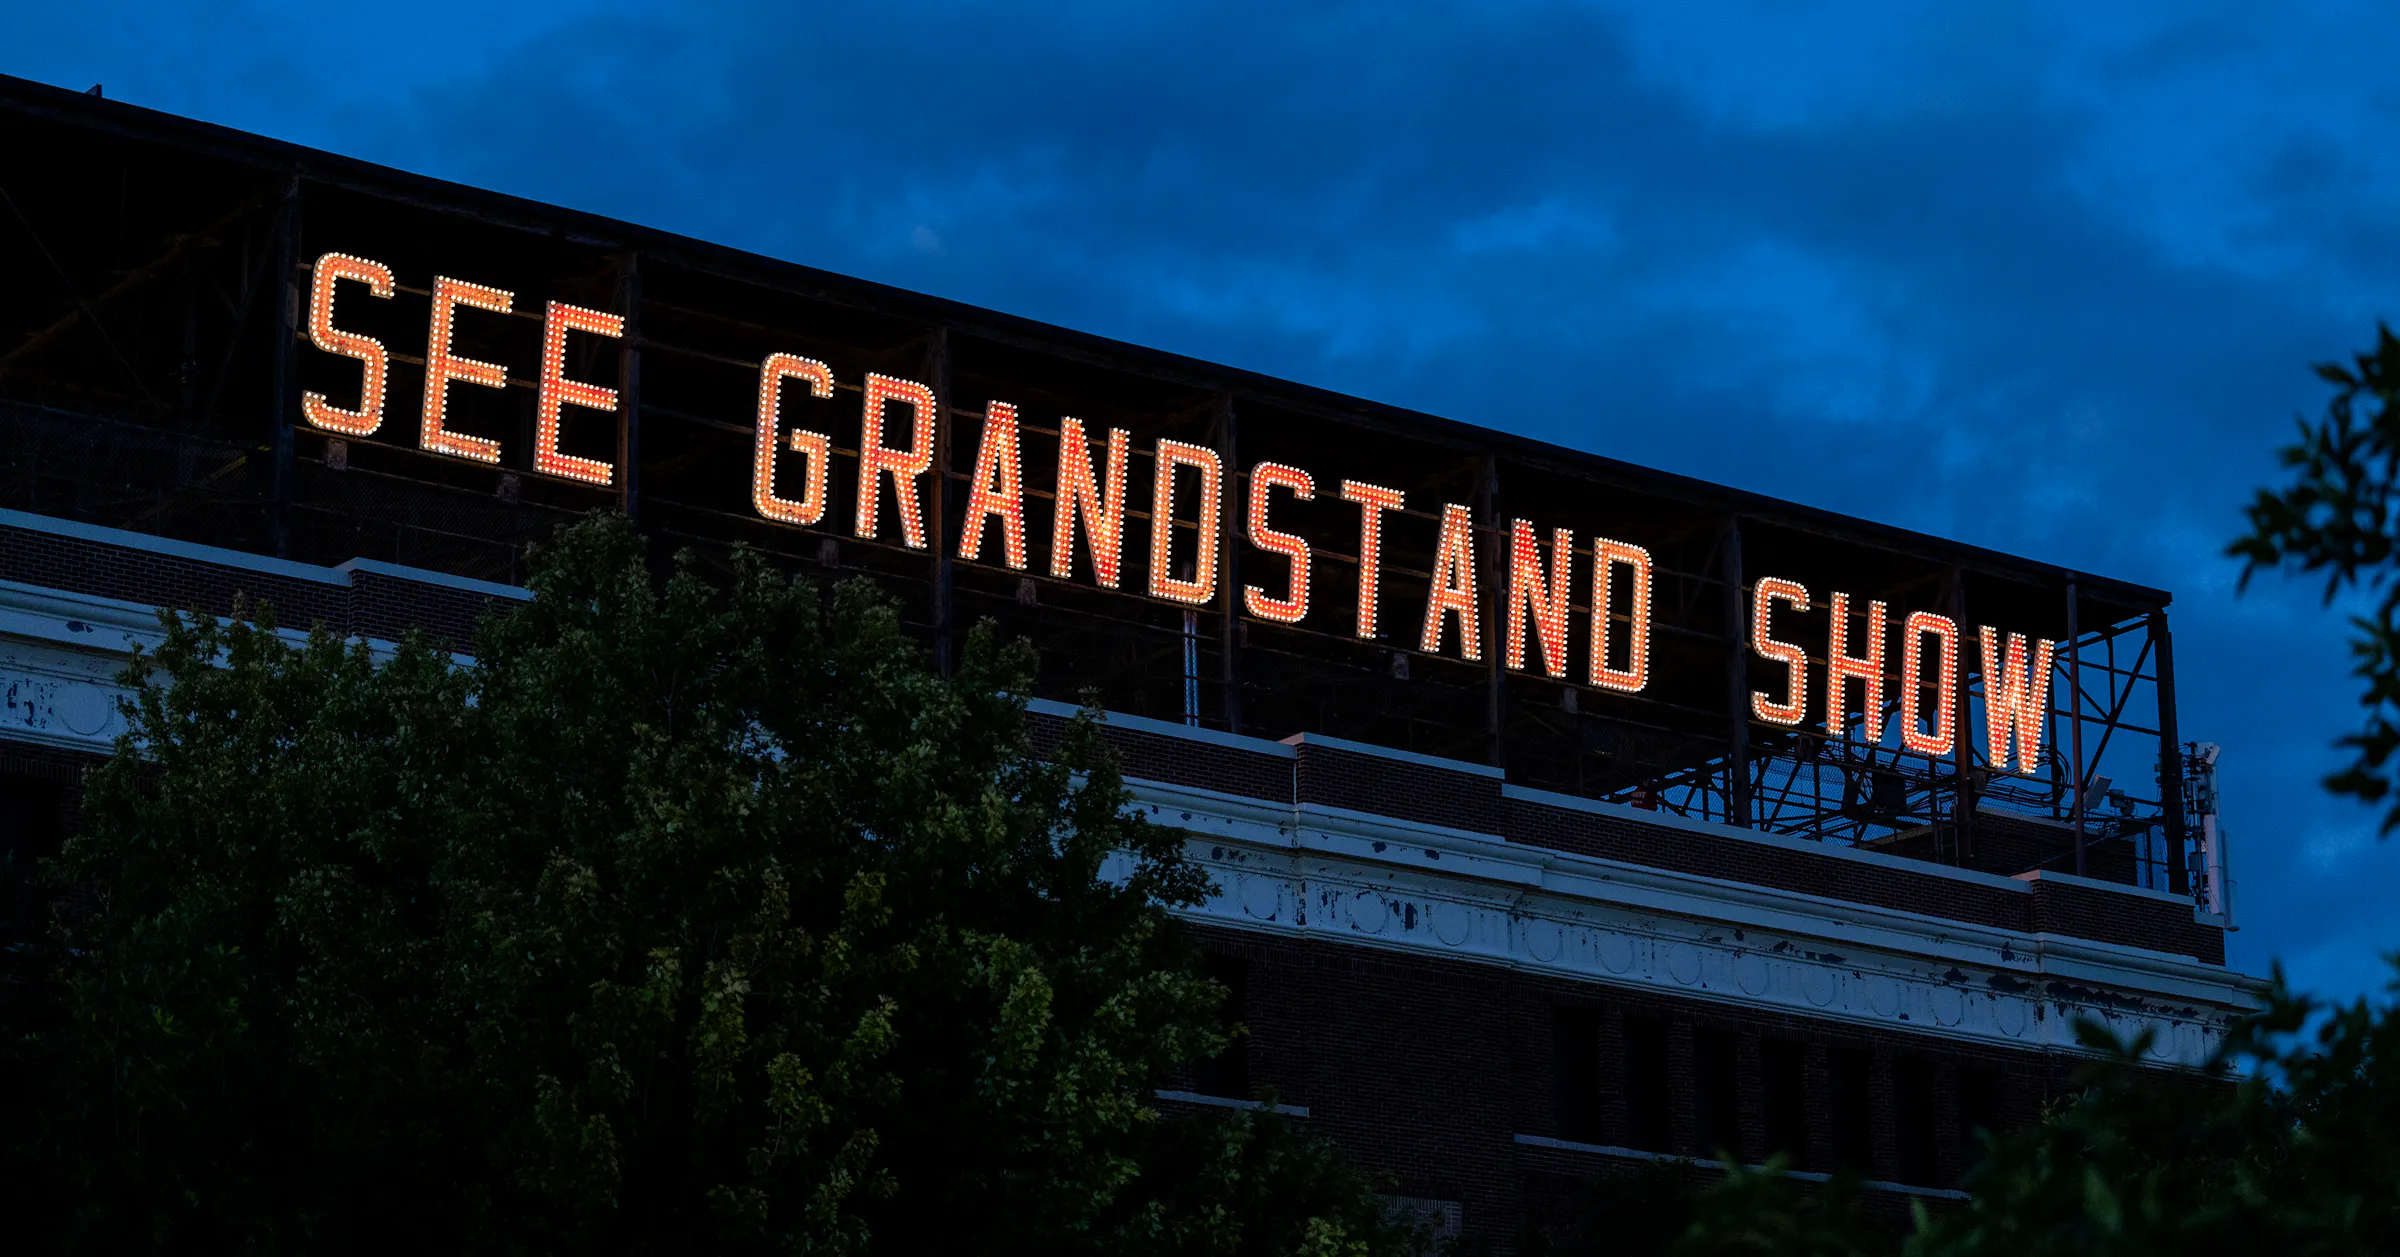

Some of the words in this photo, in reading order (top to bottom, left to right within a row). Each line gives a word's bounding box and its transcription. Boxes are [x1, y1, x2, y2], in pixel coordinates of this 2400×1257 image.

[302, 251, 627, 486] SEE
[751, 352, 1654, 694] GRANDSTAND
[1750, 576, 2055, 775] SHOW
